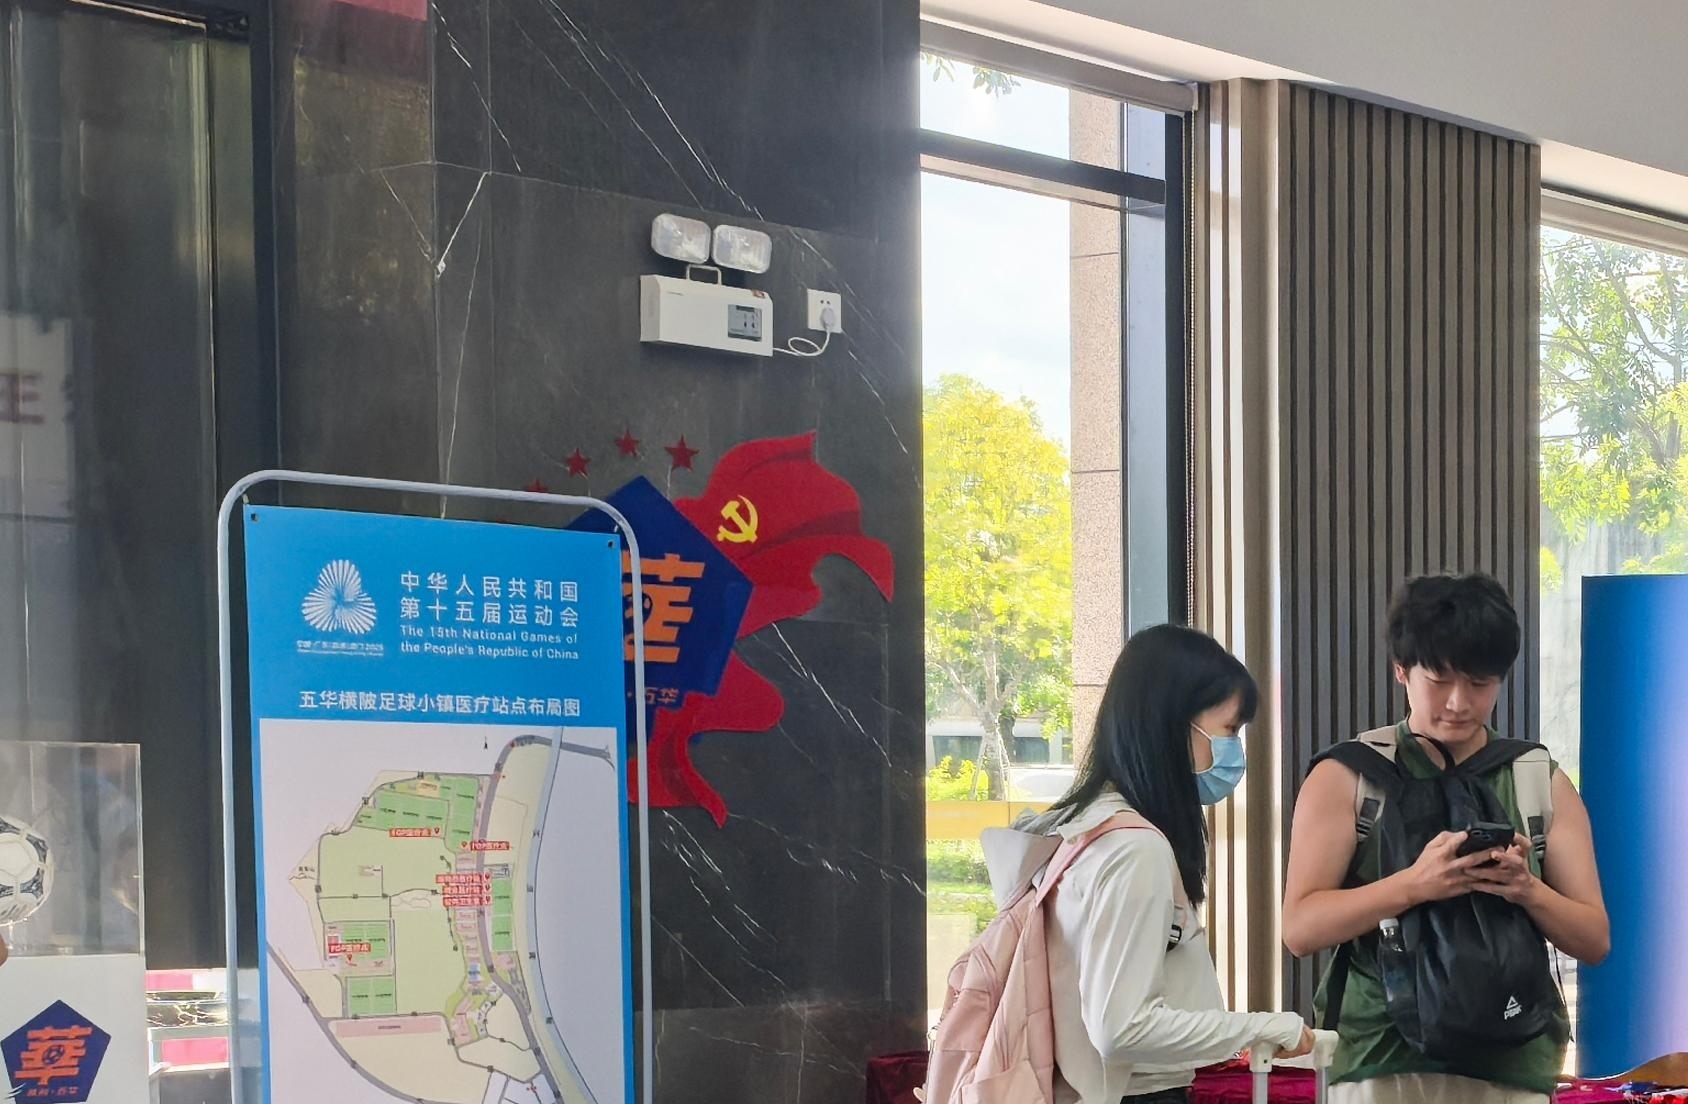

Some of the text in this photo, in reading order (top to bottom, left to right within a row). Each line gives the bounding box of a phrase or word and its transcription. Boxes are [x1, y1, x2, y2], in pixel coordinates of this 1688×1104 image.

[401, 570, 578, 602] 中华人民共和国
[400, 597, 578, 628] 第十五届运动会
[400, 625, 578, 645] The 15th National Games of
[401, 642, 579, 660] the People's Republic of China
[299, 690, 581, 717] 五华横陂足球小镇医疗站点布局图
